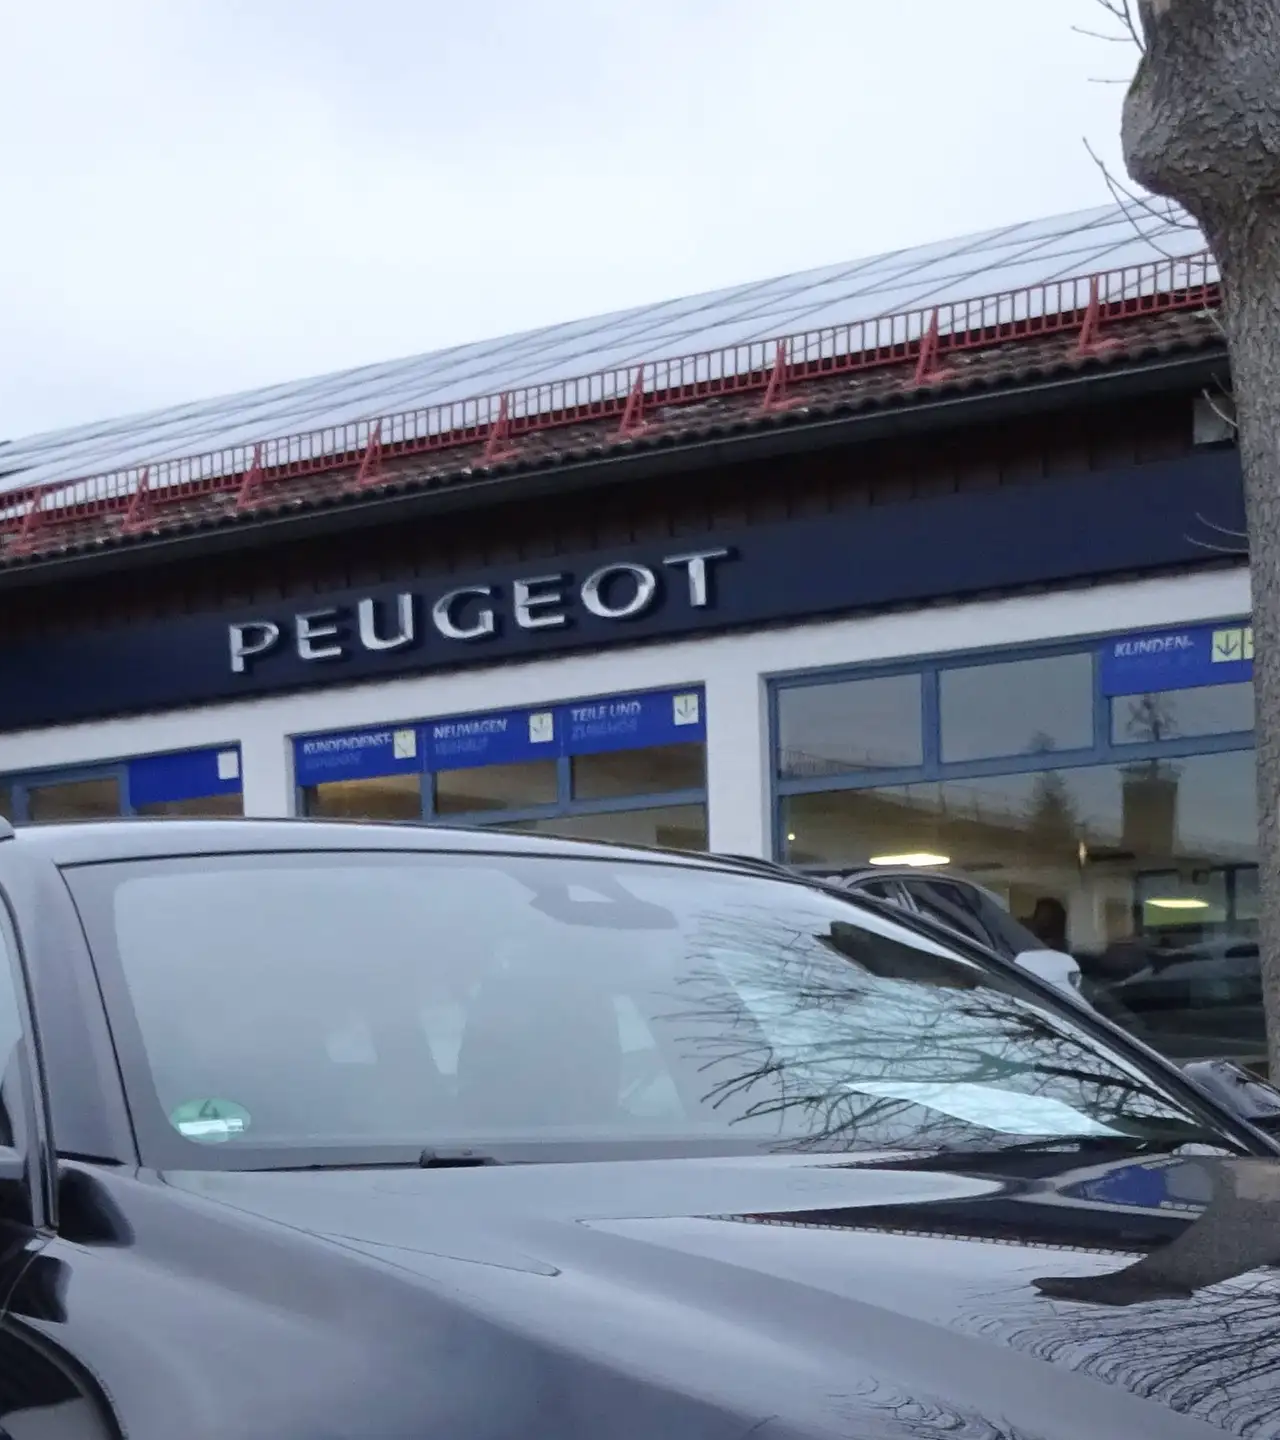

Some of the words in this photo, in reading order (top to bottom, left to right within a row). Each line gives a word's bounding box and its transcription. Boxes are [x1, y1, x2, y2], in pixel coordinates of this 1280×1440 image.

[228, 549, 730, 673] PEUGEOT
[572, 705, 607, 722] TEILE
[610, 700, 642, 718] UND
[433, 718, 508, 740] NEUWAGEN
